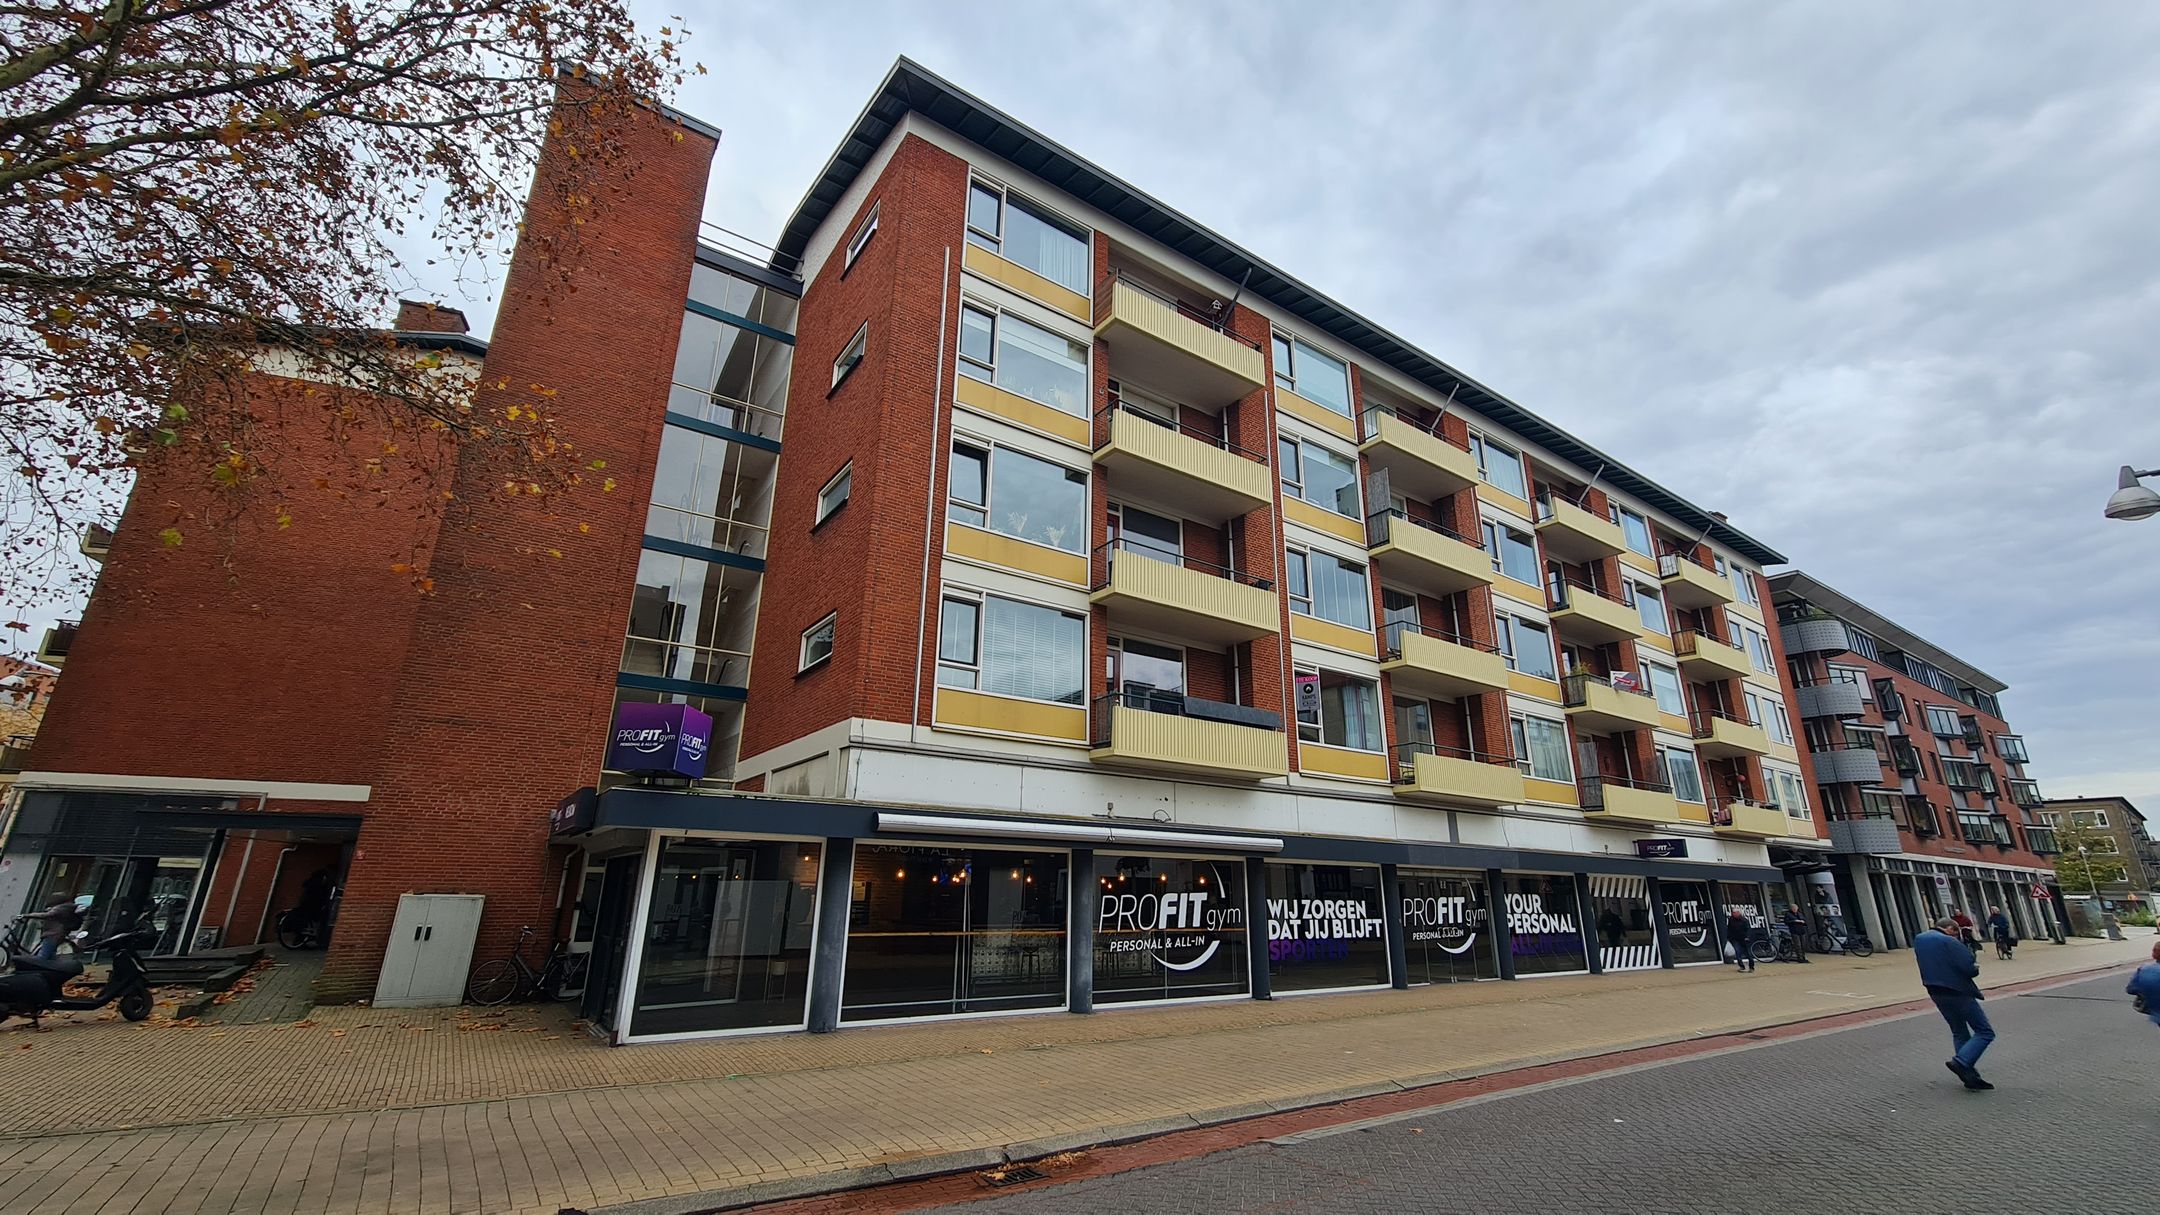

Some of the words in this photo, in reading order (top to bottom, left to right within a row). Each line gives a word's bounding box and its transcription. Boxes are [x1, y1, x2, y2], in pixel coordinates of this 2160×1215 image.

[617, 729, 662, 741] PROFIT
[659, 734, 676, 743] gym
[681, 733, 702, 749] PROFIT
[1098, 892, 1208, 934] PROFIT
[1207, 906, 1241, 931] gym
[1267, 899, 1299, 921] WIJ
[1302, 898, 1367, 920] ZORGEN
[1403, 896, 1466, 927] PROFIT
[1466, 908, 1487, 927] gym
[1504, 893, 1543, 914] YOUR
[1662, 900, 1698, 924] PROFIT
[1268, 920, 1303, 941] DAT
[1305, 919, 1329, 939] JIJ
[1332, 918, 1383, 938] BLIJFT
[1507, 913, 1576, 935] PERSONAL
[1109, 938, 1163, 953] PERSONAL
[1165, 937, 1173, 948] &
[1175, 935, 1205, 948] ALL-IN
[1412, 931, 1441, 941] PERSONAL
